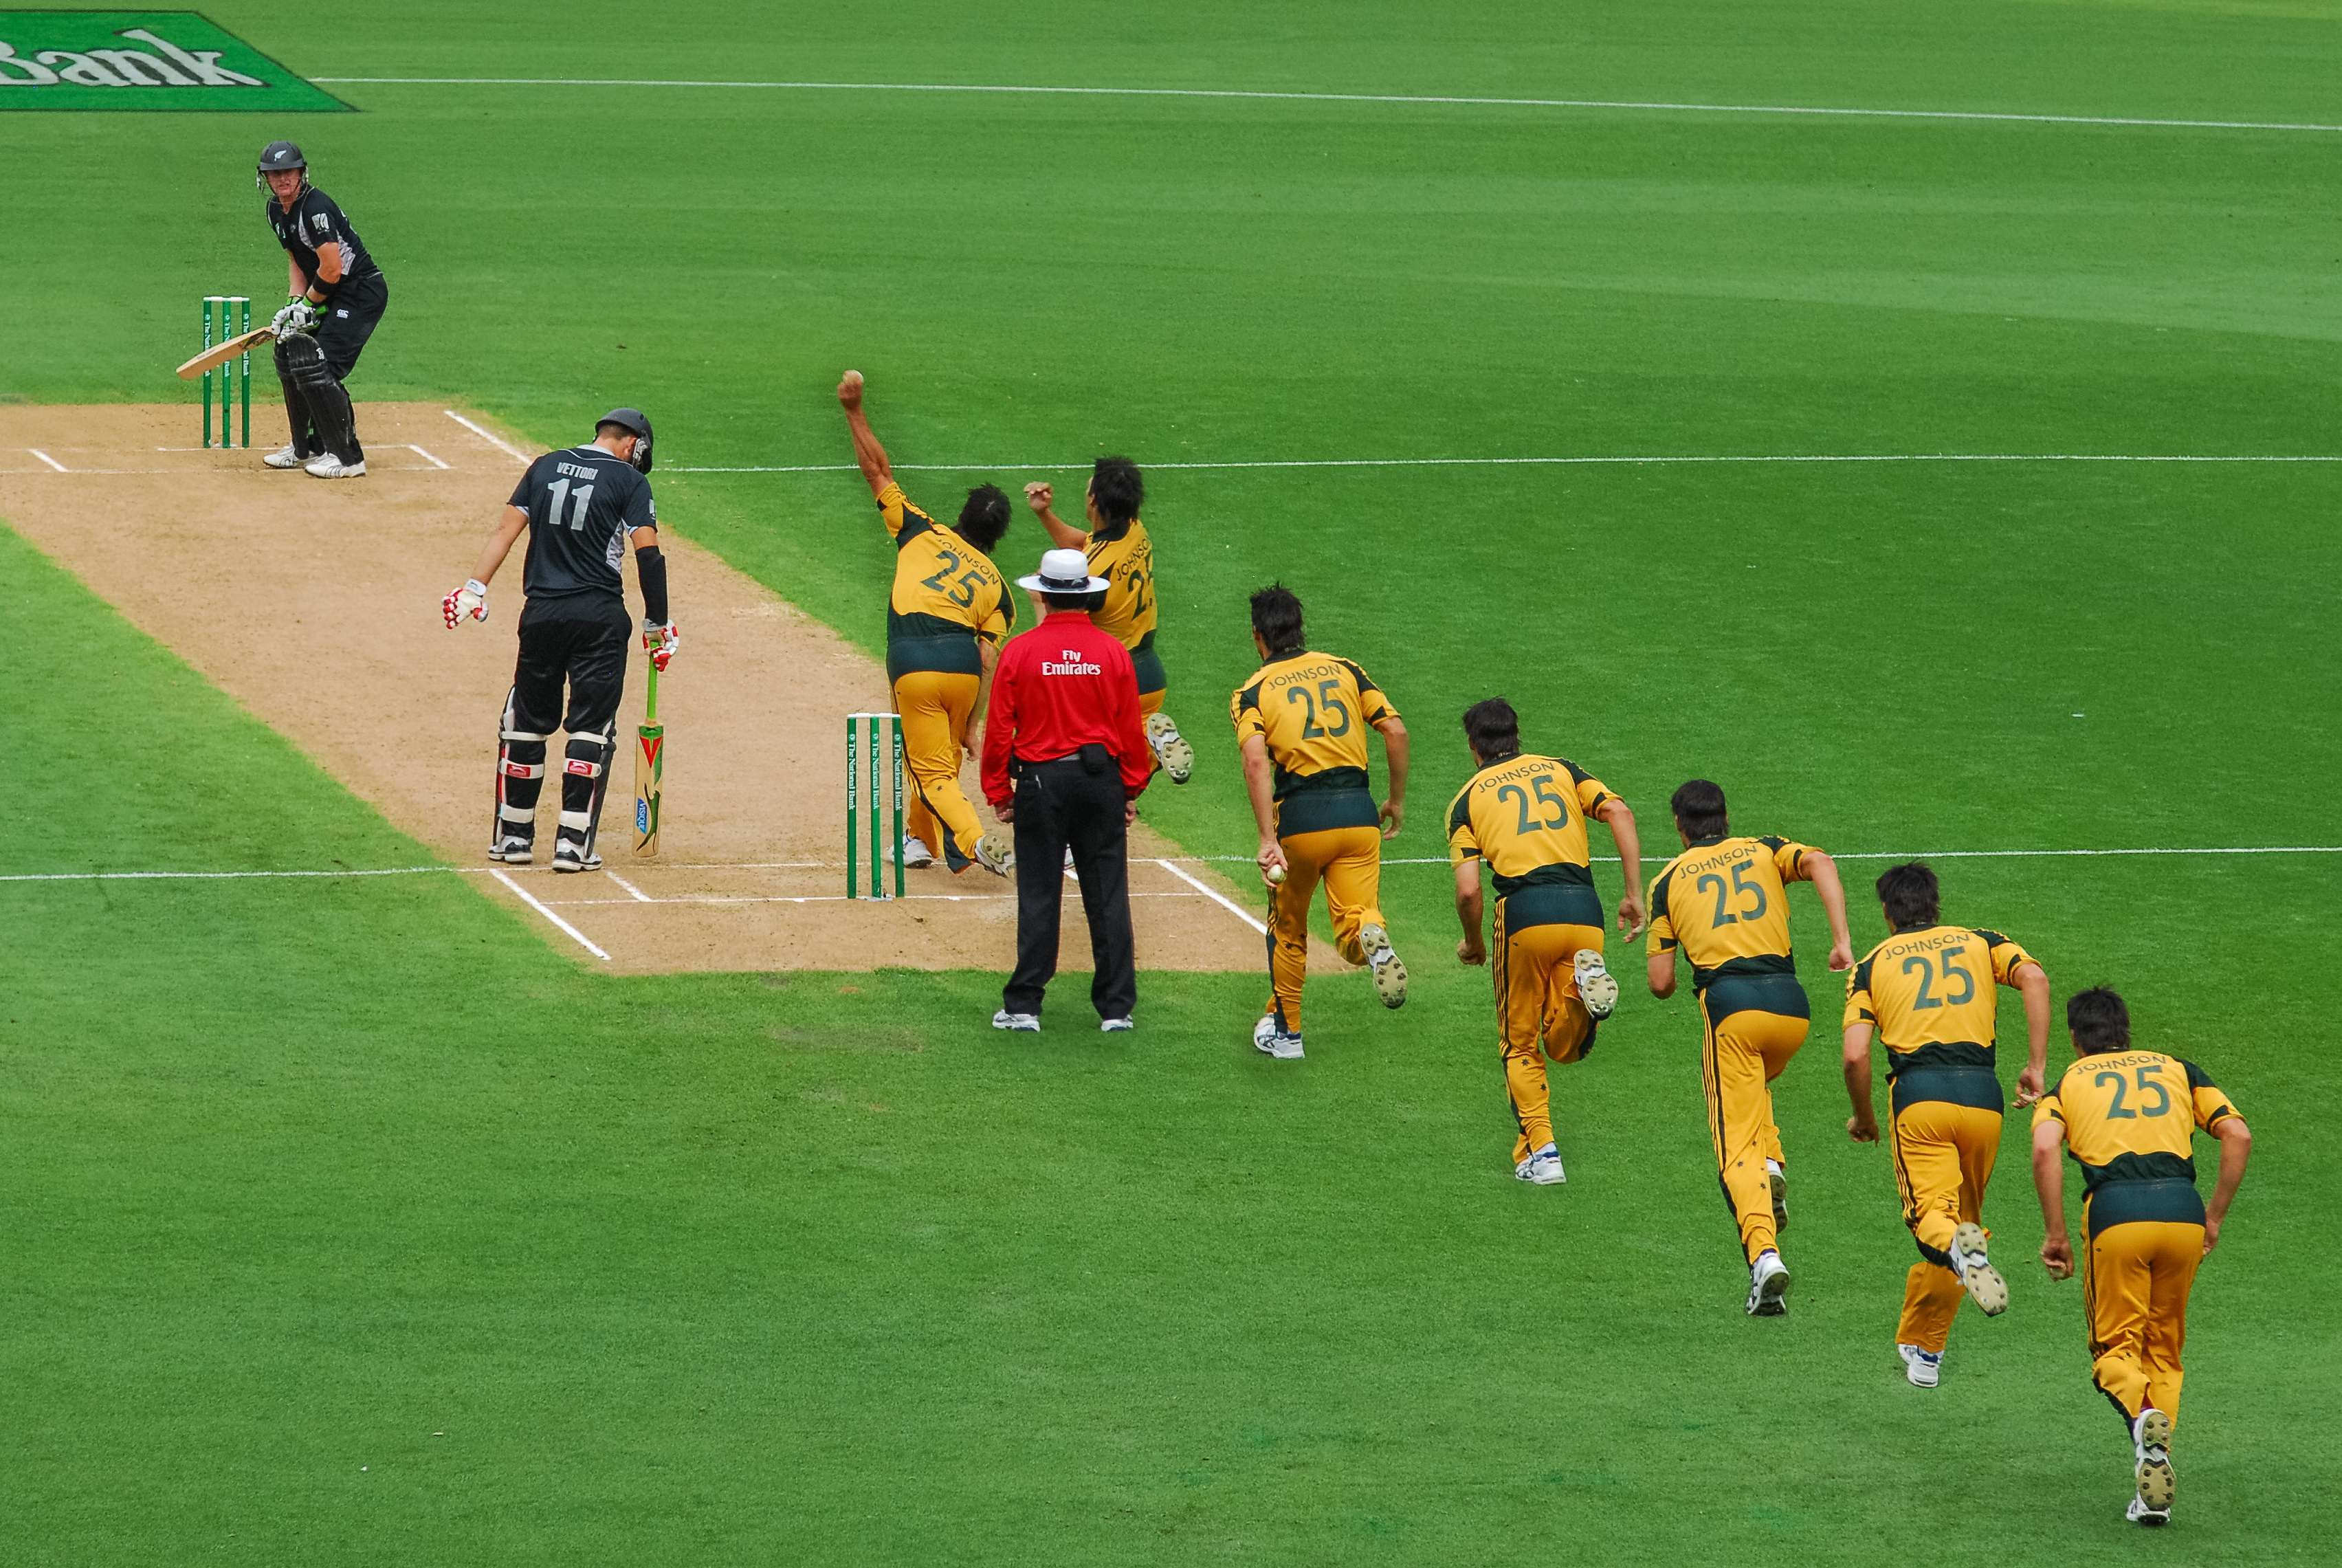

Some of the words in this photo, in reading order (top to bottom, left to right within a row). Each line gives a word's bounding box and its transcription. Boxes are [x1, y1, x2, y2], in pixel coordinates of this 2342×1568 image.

[556, 462, 599, 481] VETTORI
[547, 478, 595, 531] 11
[936, 538, 999, 585] JOHNSON
[1116, 538, 1149, 581] JOHNSO
[920, 550, 988, 608] 25
[1041, 661, 1101, 676] Emirates
[1062, 650, 1081, 662] Fly
[1269, 664, 1342, 691] JOHNSON
[1287, 679, 1349, 740] 25
[1479, 762, 1556, 793] JOHNSON
[894, 791, 903, 811] Bank
[1497, 774, 1568, 835] 25
[1680, 845, 1757, 879] JOHNSON
[1697, 859, 1767, 930] 25
[1886, 934, 1969, 960] JOHNSON
[1903, 945, 1975, 1011] 25
[2076, 1055, 2166, 1075] JOHNSON
[2095, 1064, 2170, 1120] 25
